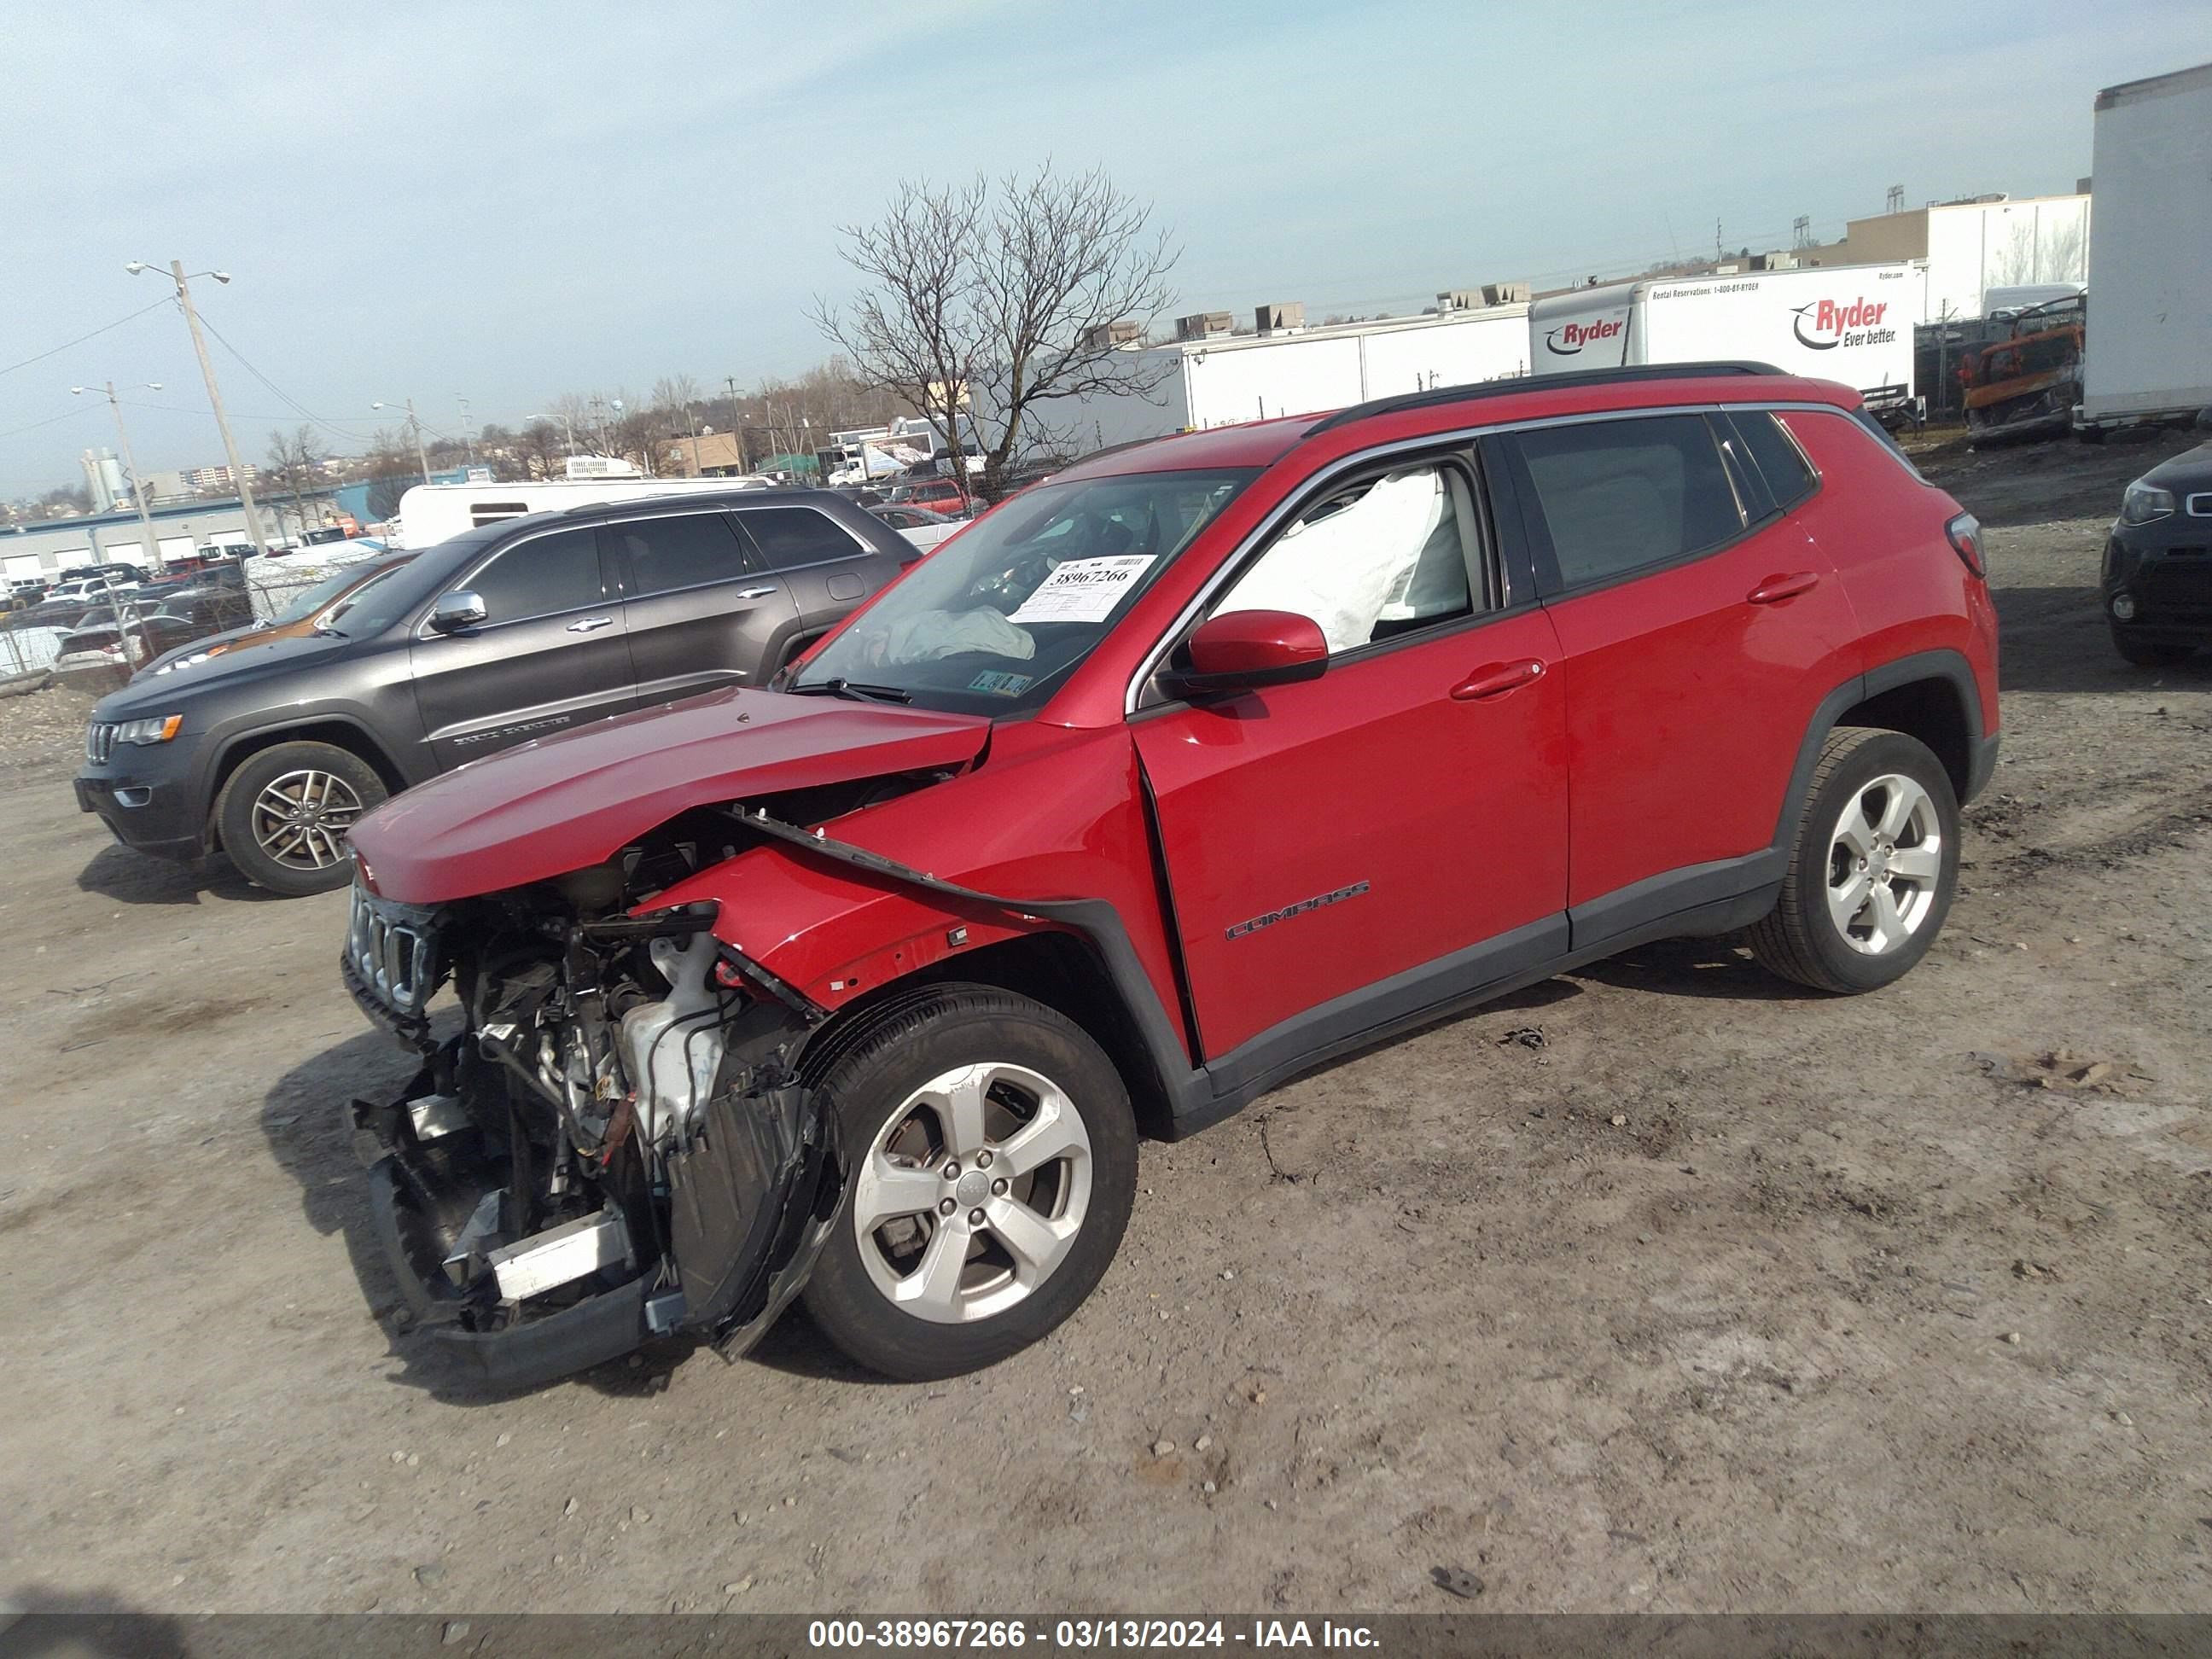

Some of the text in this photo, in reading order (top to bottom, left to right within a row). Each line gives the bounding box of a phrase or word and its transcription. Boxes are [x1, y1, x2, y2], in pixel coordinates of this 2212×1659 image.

[1878, 272, 1904, 281] Ryder.com
[1653, 291, 1672, 300] Rental
[1816, 297, 1888, 337] Ryder
[1563, 319, 1622, 346] Ryder
[1843, 328, 1895, 347] Ever better.
[1050, 569, 1133, 587] 38967266
[1225, 880, 1371, 941] COMPASS
